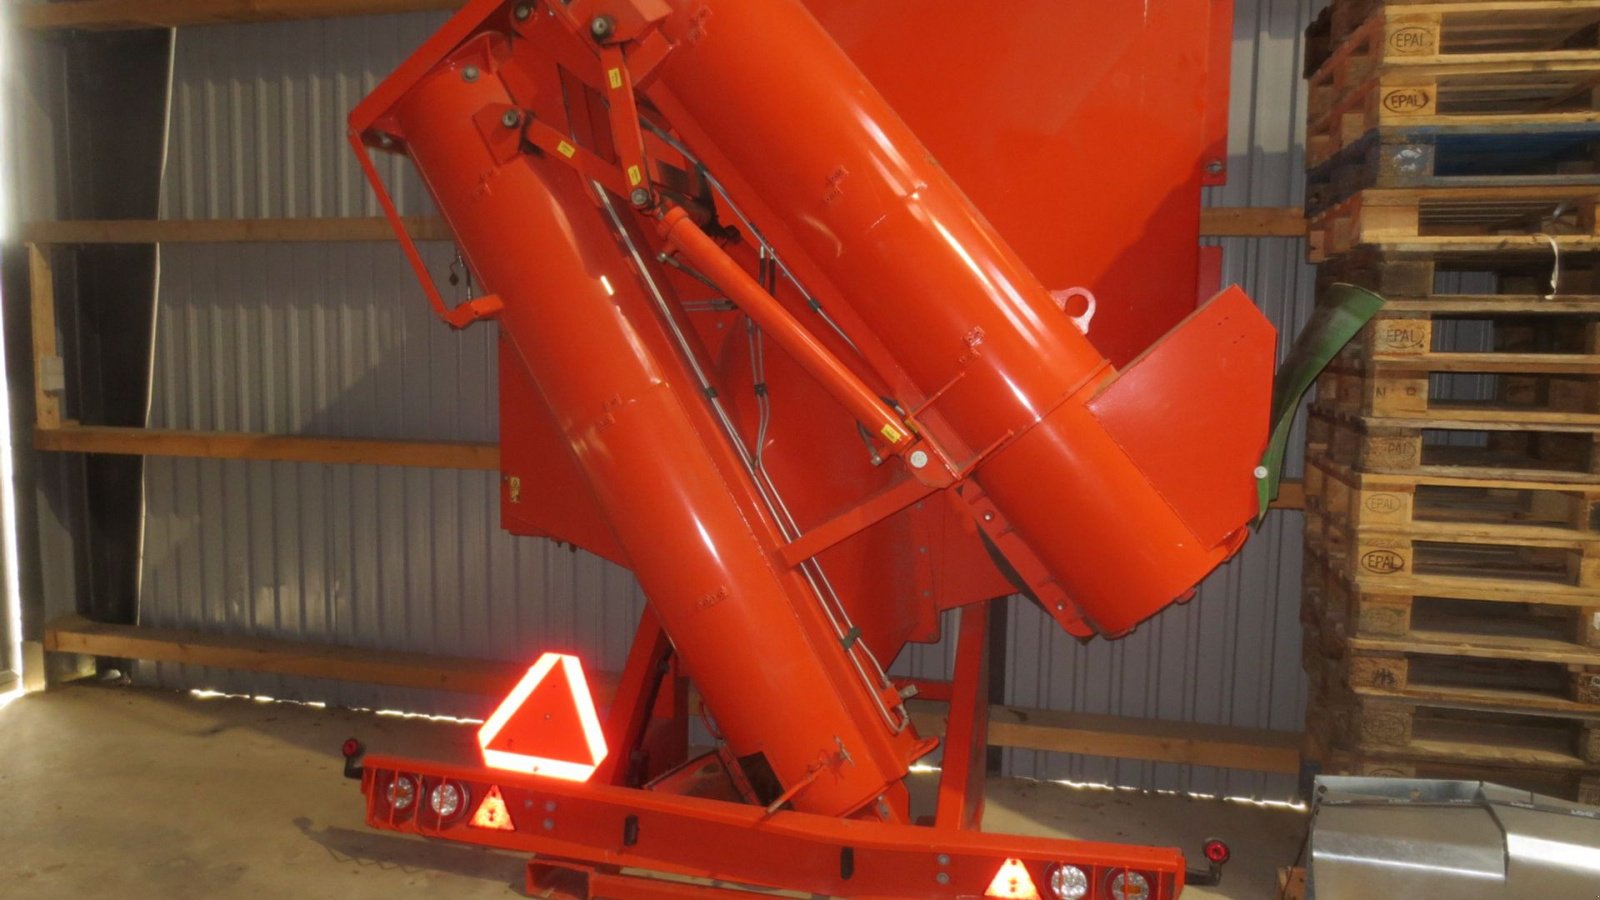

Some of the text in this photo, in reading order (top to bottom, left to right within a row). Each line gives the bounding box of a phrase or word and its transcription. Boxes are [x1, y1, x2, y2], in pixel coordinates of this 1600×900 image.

[1391, 93, 1422, 109] EPAL
[1386, 328, 1416, 343] EPAL
[1370, 497, 1395, 509] EPAL
[1368, 553, 1398, 570] EPAL
